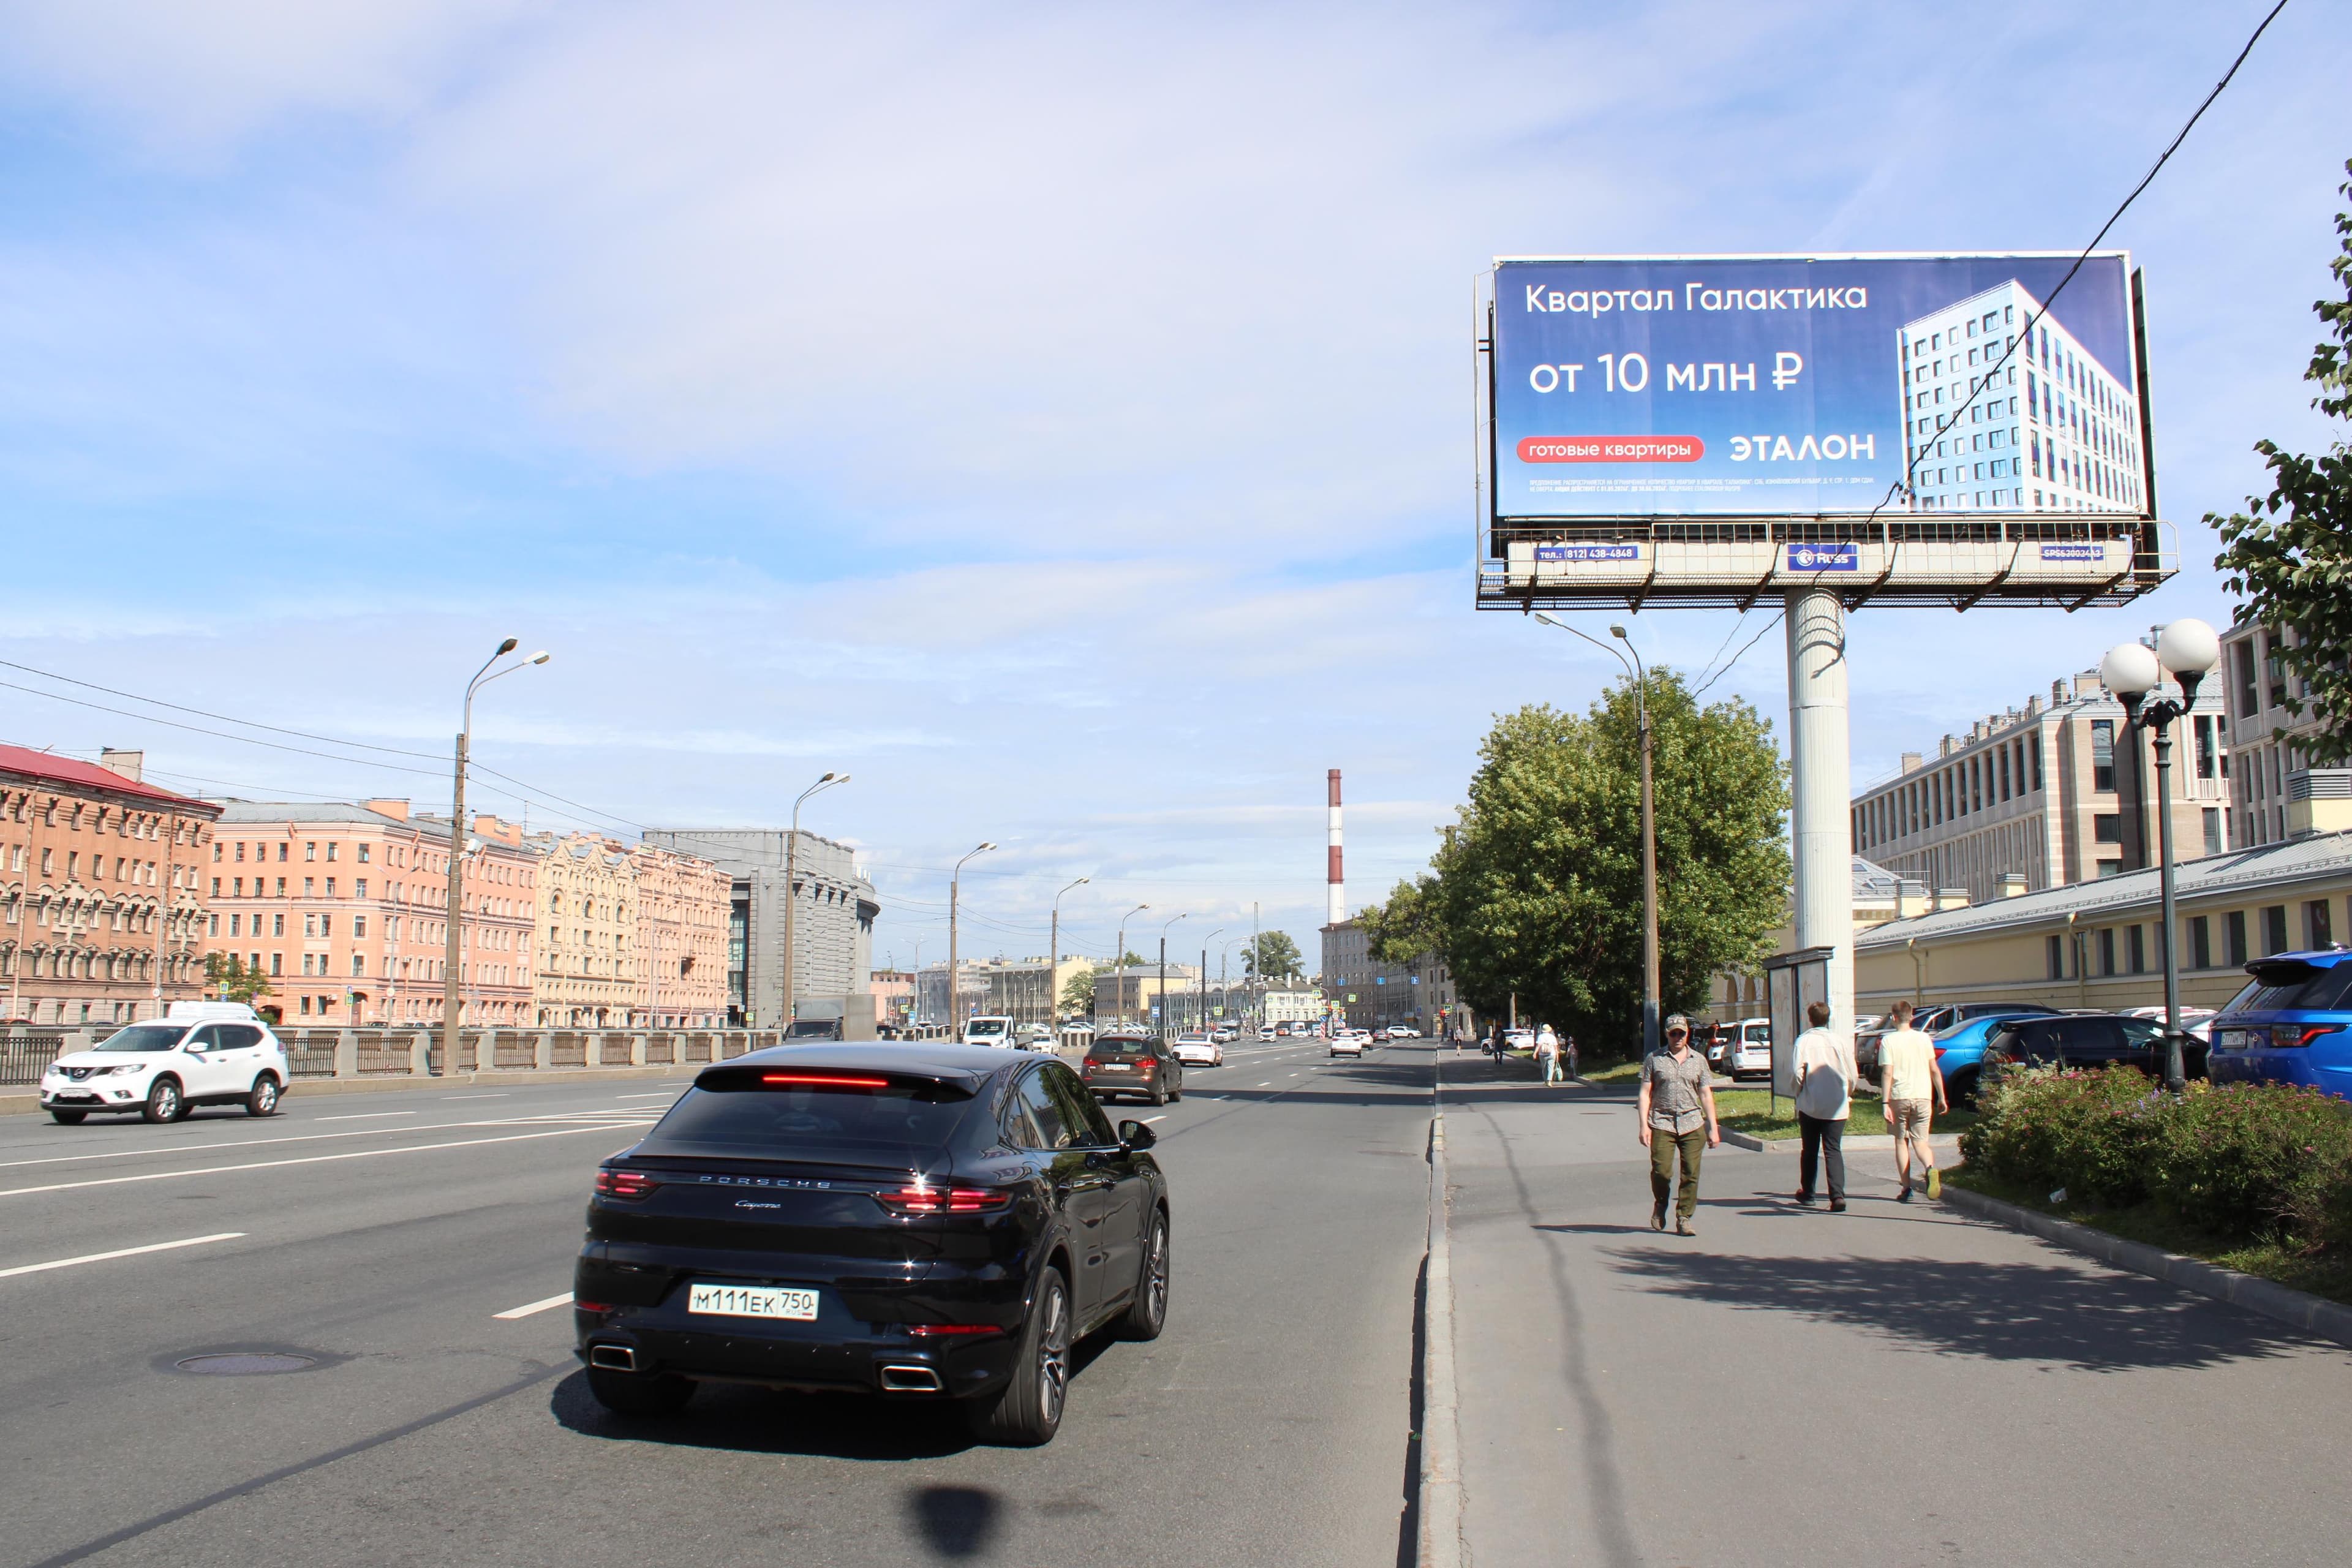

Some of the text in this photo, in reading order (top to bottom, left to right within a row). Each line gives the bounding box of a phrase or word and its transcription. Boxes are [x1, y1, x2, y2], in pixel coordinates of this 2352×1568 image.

[1526, 282, 1868, 318] Квартал Галактика
[1529, 364, 1583, 393] от
[1597, 353, 1649, 393] 10
[1667, 363, 1756, 391] млн
[1529, 443, 1692, 459] готовые квартиры
[1729, 434, 1875, 462] ЭТАЛОН
[1564, 549, 1586, 559] (812)
[1589, 549, 1632, 558] 438-4848
[699, 1175, 831, 1189] PORSCHE
[734, 1199, 782, 1210] Cayenne
[696, 1289, 812, 1313] М111ЕК 750
